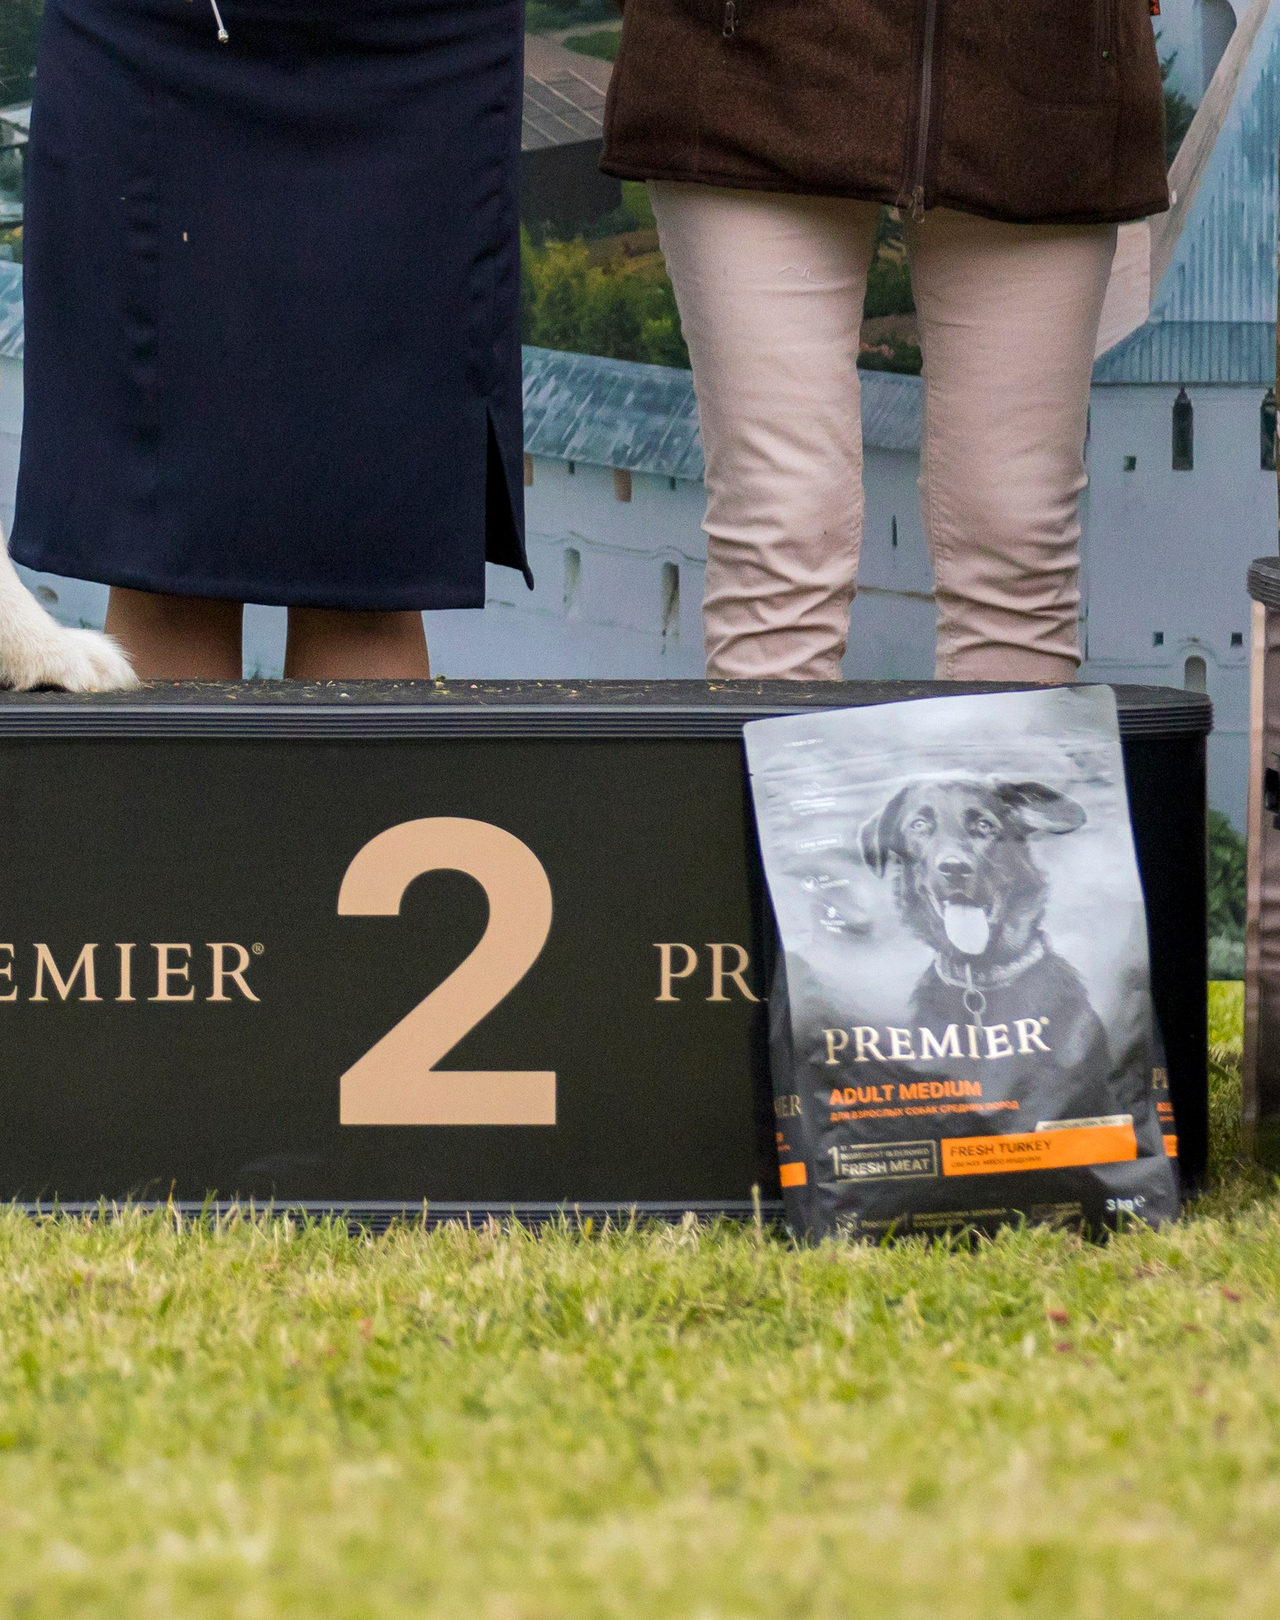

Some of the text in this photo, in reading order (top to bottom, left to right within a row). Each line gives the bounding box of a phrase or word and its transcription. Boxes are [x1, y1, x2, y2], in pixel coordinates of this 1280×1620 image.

[337, 817, 557, 1126] 2
[651, 942, 769, 1002] PR
[829, 1080, 983, 1106] ADULT MEDIUM
[949, 1139, 1053, 1157] FRESH TURKEY
[840, 1158, 930, 1177] FRESH MEAT
